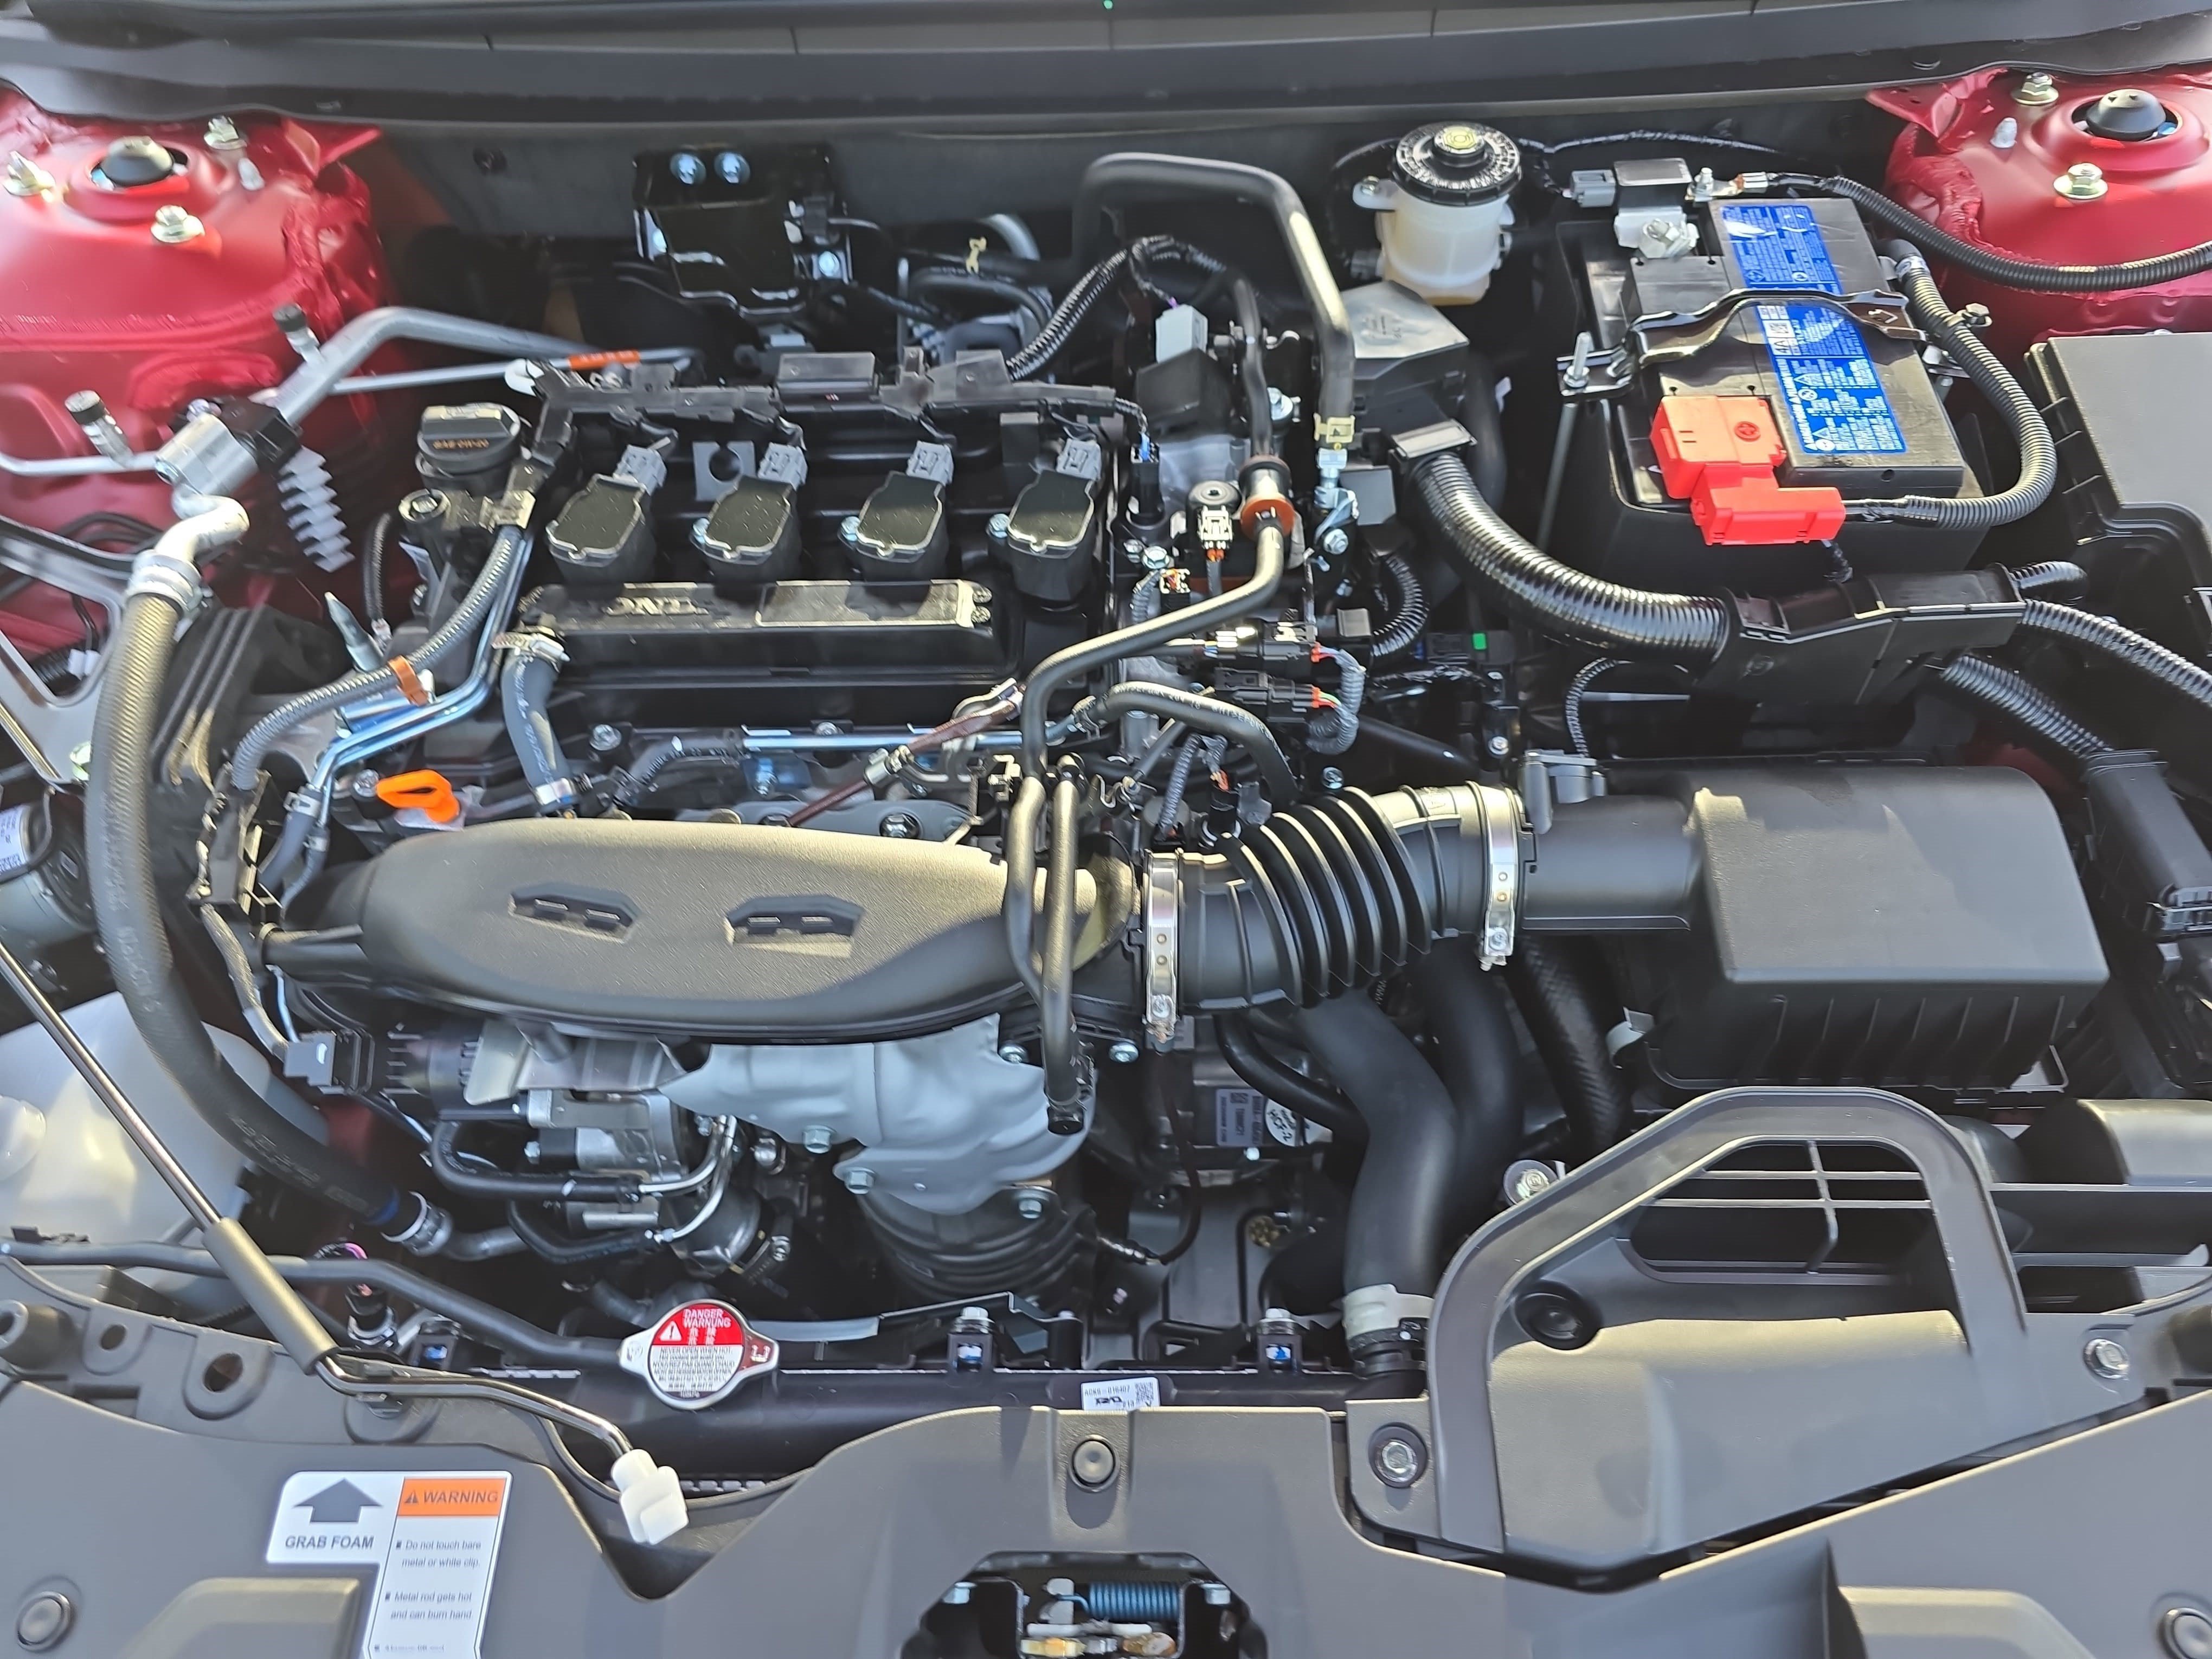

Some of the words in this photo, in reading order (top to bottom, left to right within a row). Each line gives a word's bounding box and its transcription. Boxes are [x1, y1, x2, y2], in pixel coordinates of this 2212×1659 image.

[683, 1309, 724, 1319] DANGER
[683, 1317, 732, 1328] WARNUNG
[423, 1490, 498, 1503] WARNING
[285, 1535, 326, 1549] GRAB
[331, 1535, 375, 1549] FOAM
[406, 1541, 418, 1550] Do
[420, 1541, 434, 1550] not
[436, 1540, 460, 1550] touch
[462, 1541, 481, 1550] bare
[402, 1558, 425, 1568] metal
[439, 1558, 461, 1568] white
[395, 1592, 418, 1602] Metal
[421, 1592, 435, 1602] rod
[437, 1592, 456, 1604] gets
[458, 1592, 472, 1602] hot
[390, 1610, 408, 1620] and
[409, 1612, 425, 1620] can
